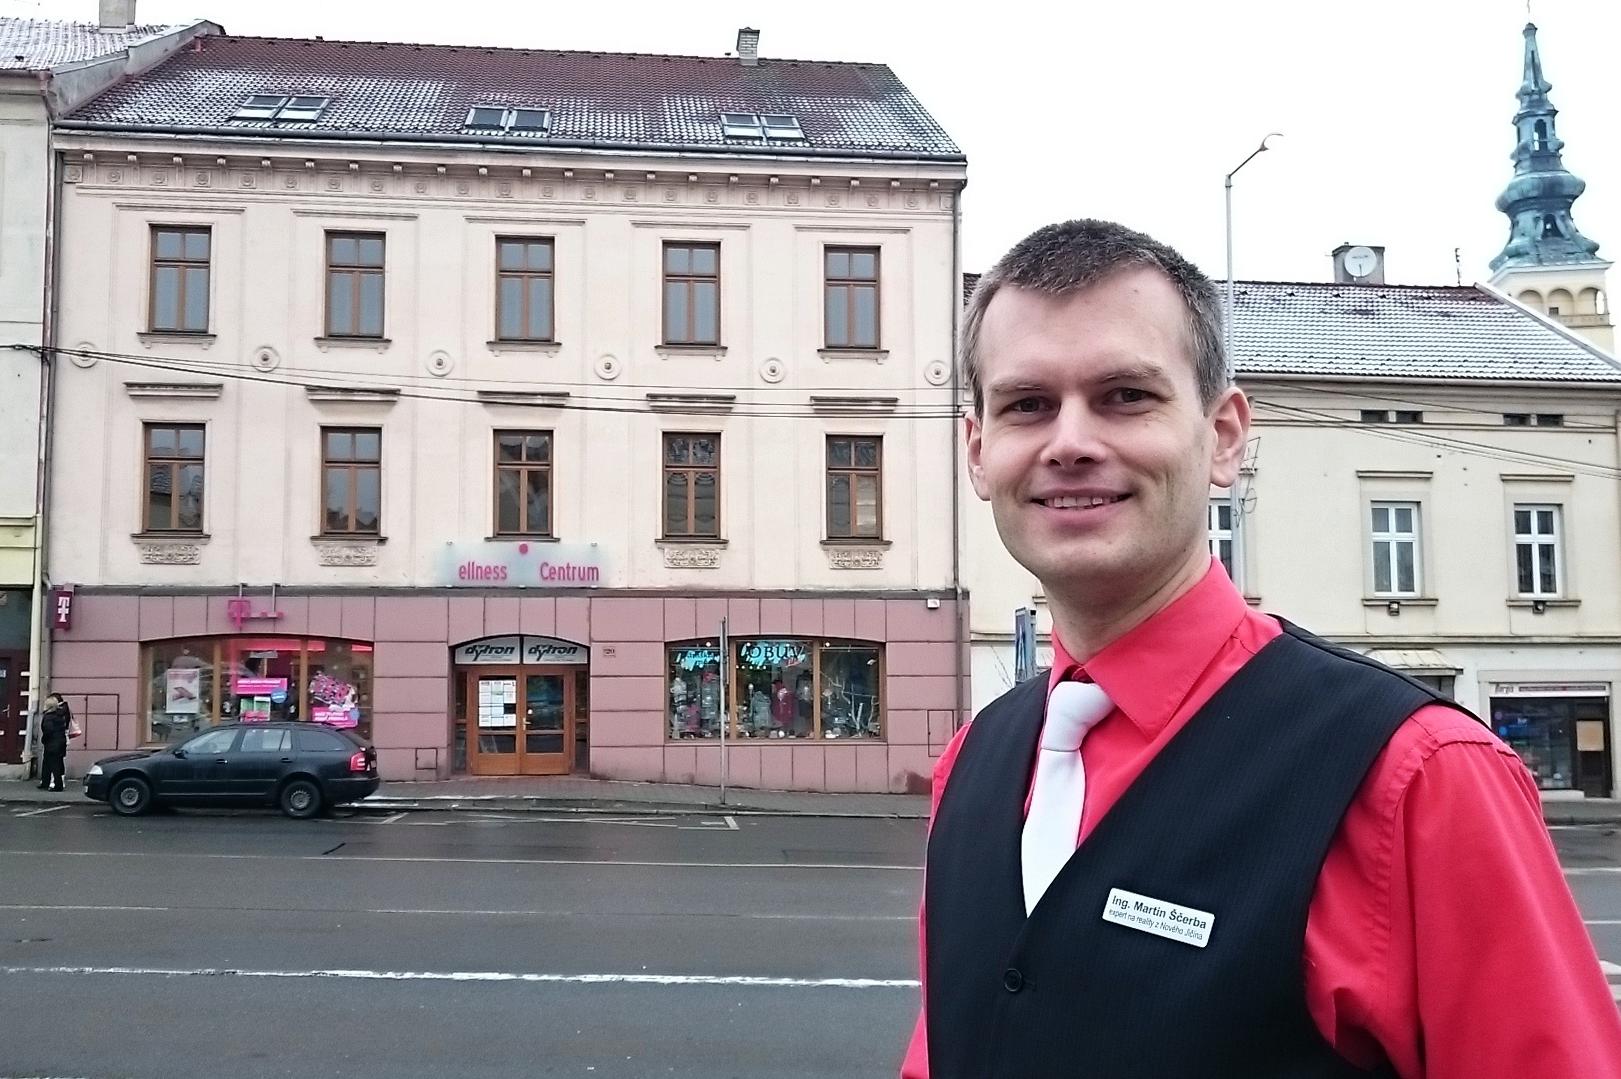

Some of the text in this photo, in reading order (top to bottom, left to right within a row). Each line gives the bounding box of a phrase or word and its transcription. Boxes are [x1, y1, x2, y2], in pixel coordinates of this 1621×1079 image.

[458, 562, 600, 581] ellness Centrum
[464, 644, 515, 661] dytron
[528, 644, 579, 661] dytron
[748, 646, 804, 660] OBUV
[1111, 895, 1206, 929] Ing. Martin Ščerba
[1136, 916, 1154, 928] reality
